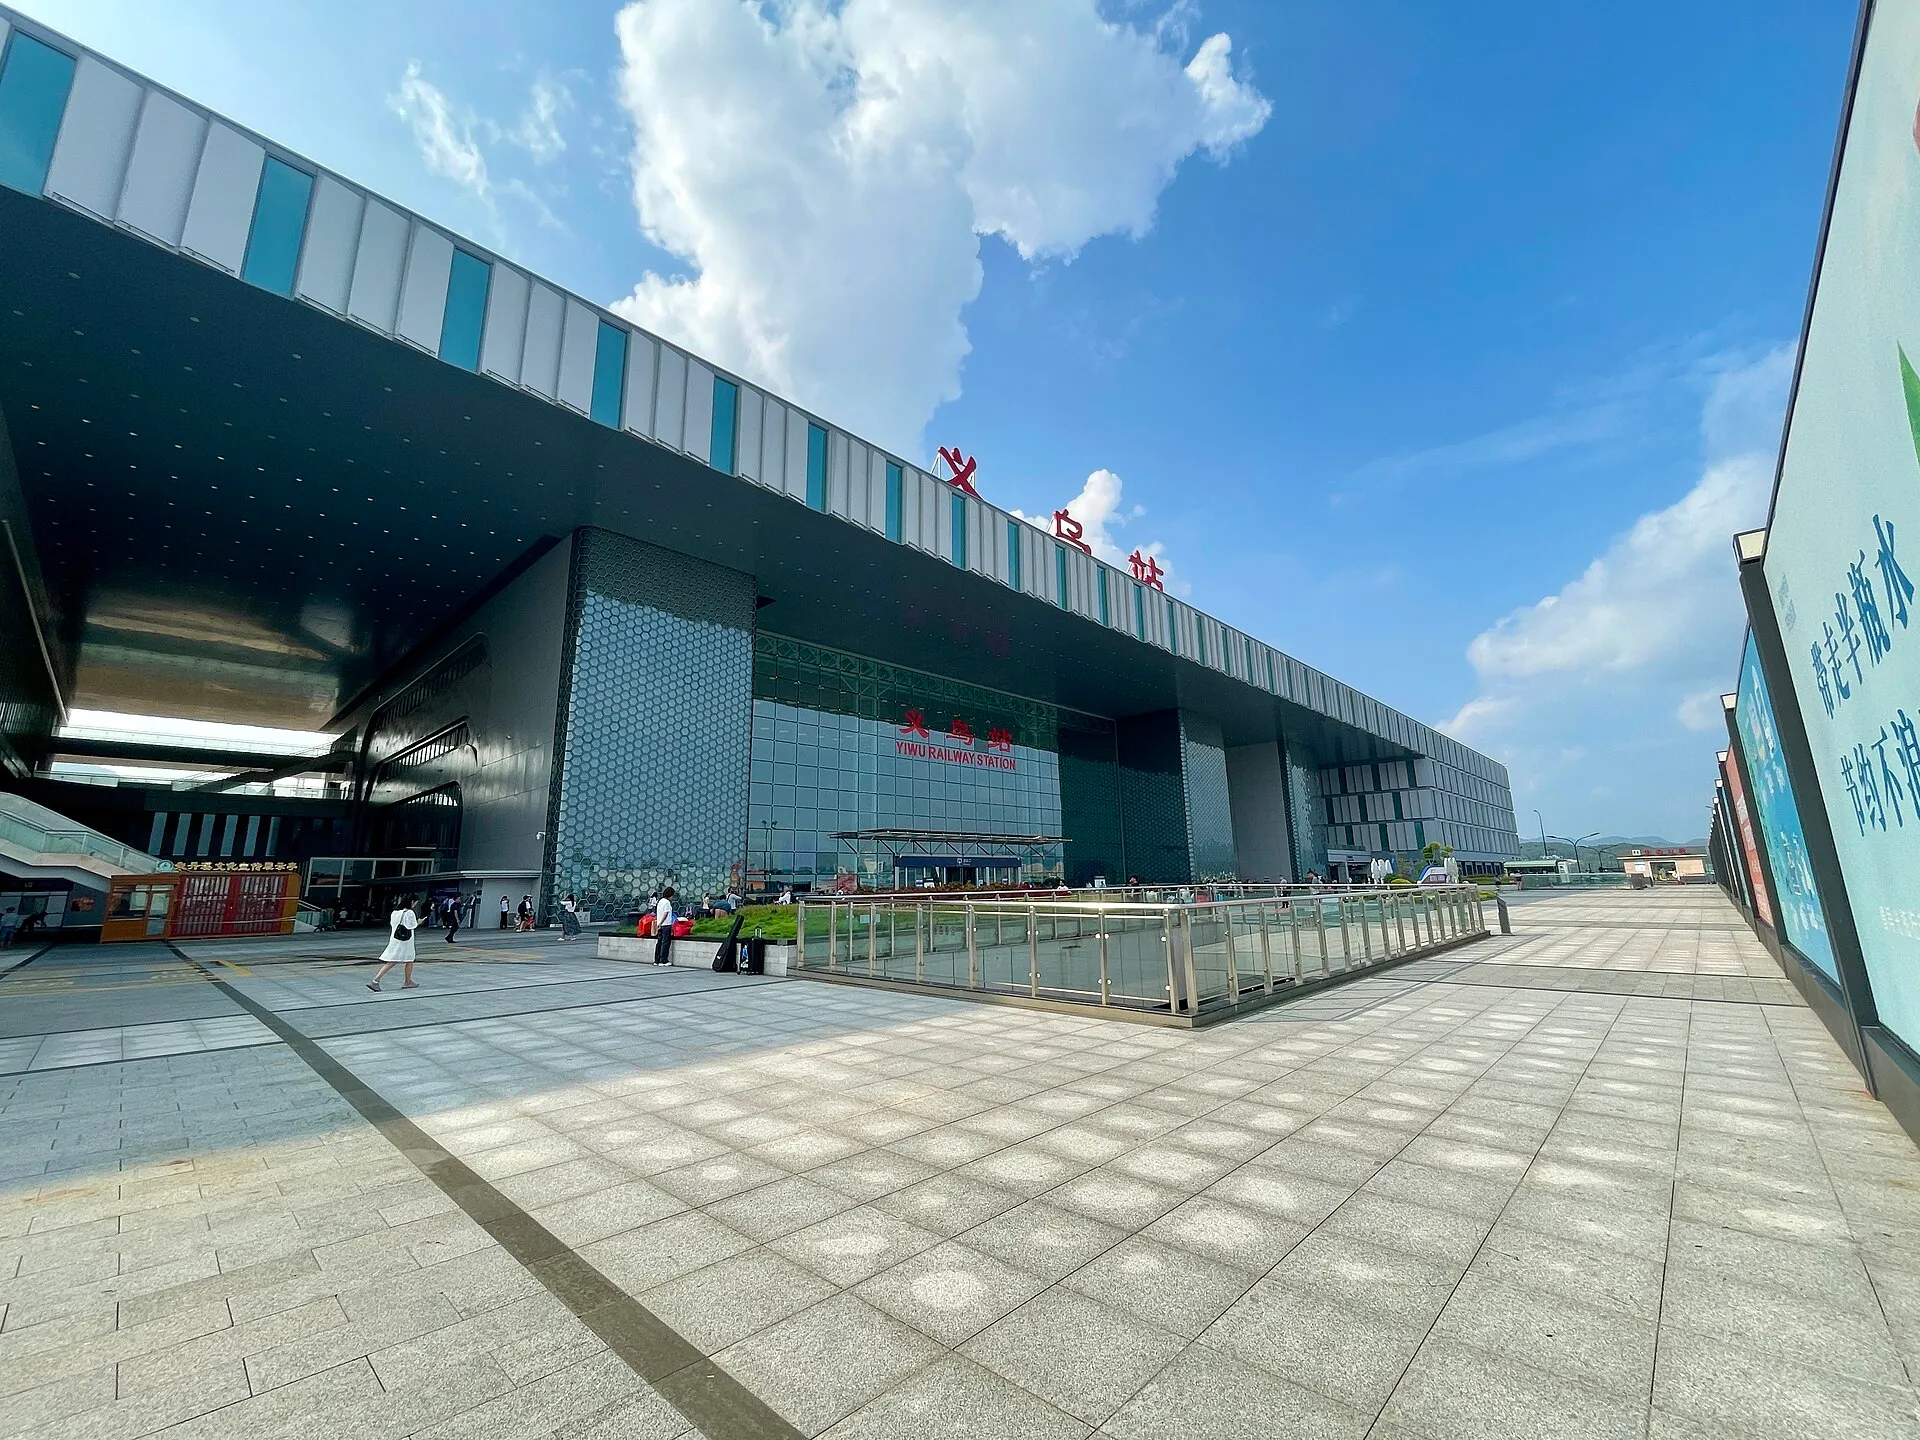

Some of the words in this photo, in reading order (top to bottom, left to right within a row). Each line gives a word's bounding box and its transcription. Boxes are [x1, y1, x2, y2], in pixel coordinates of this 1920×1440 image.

[1810, 513, 1915, 720] 带走半瓶水
[899, 708, 1013, 753] 义乌站
[896, 741, 926, 758] YIWU
[928, 745, 975, 765] RAILWAY
[977, 753, 1016, 771] STATION
